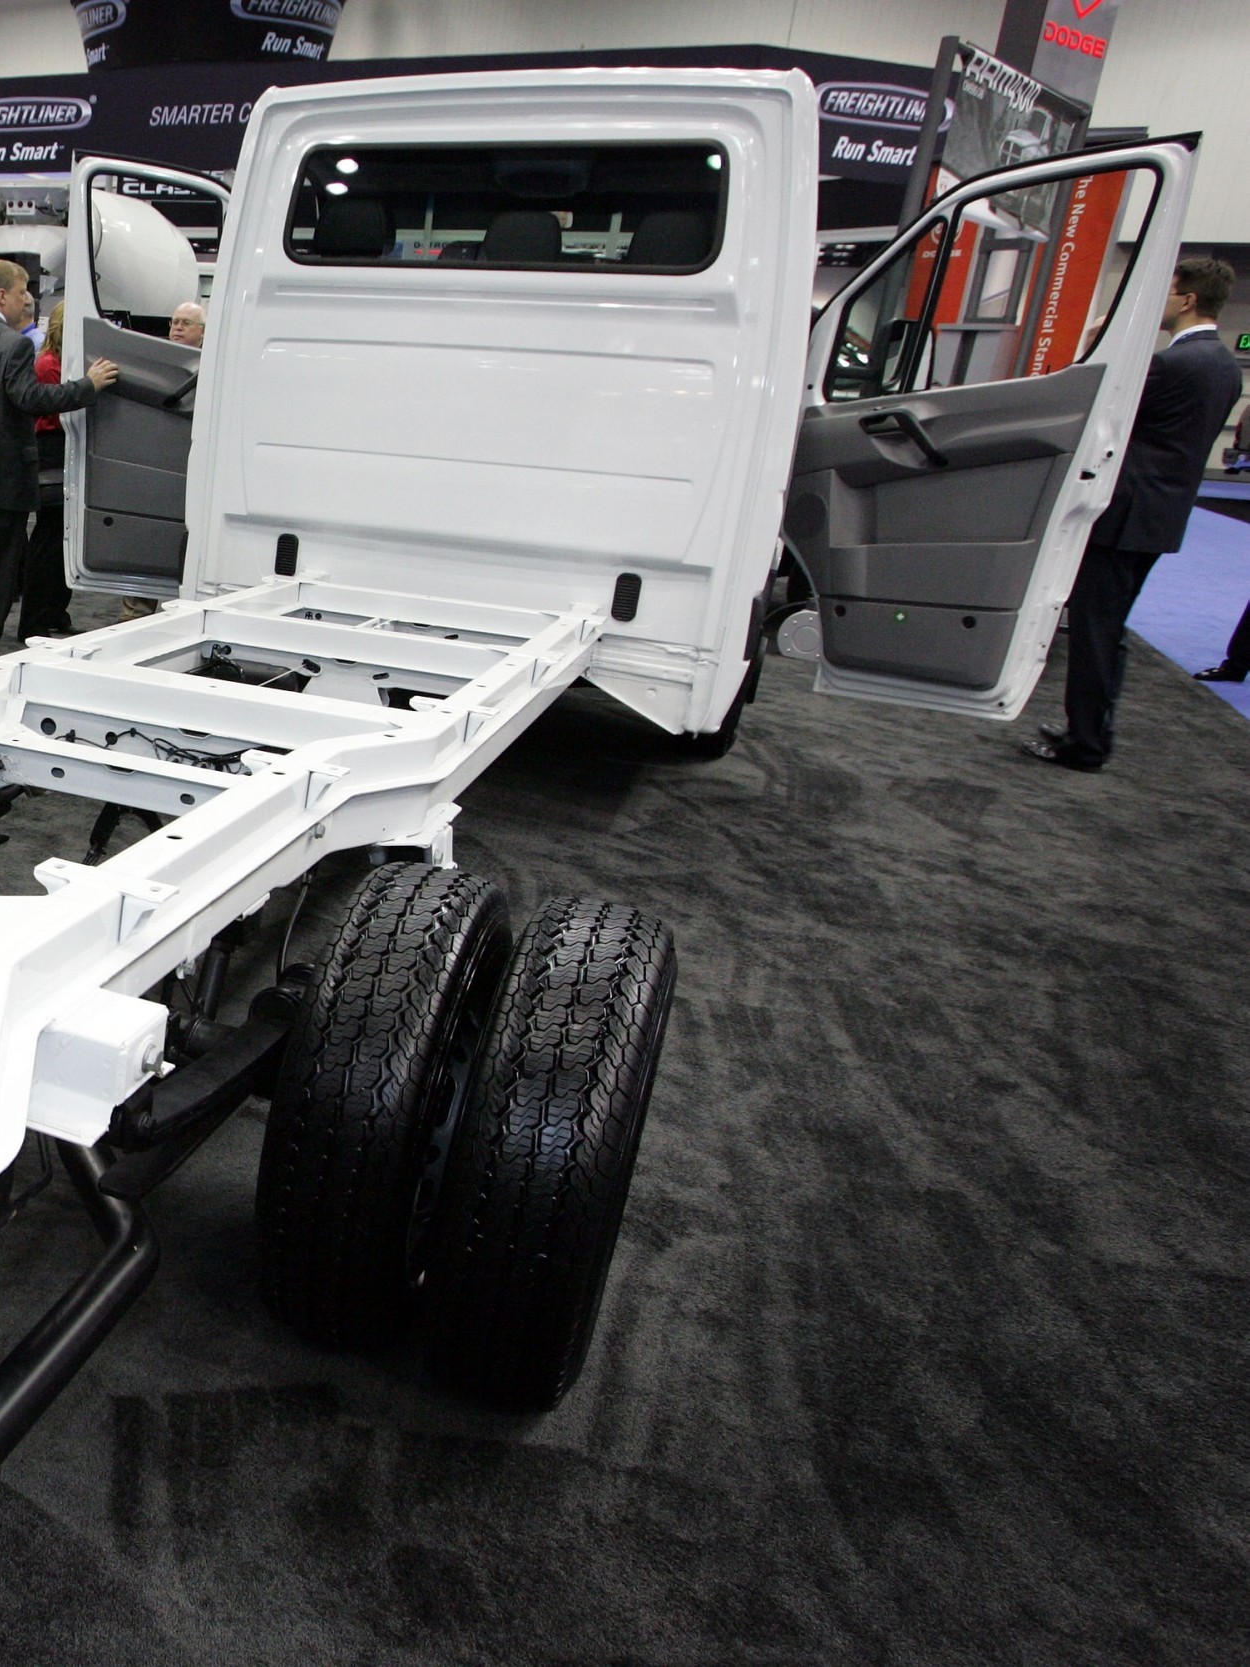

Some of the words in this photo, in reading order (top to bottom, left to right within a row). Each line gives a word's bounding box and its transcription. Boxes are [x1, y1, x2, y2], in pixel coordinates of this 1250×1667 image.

[261, 31, 291, 53] Run
[293, 36, 324, 60] Smart
[1043, 20, 1107, 59] DODGE
[150, 103, 233, 126] SMARTER
[824, 91, 927, 122] FREIGHTLIN
[10, 142, 58, 161] Smart
[832, 136, 866, 161] Run
[867, 140, 917, 166] Smart
[1065, 203, 1087, 238] New
[1041, 242, 1076, 333] Commercial
